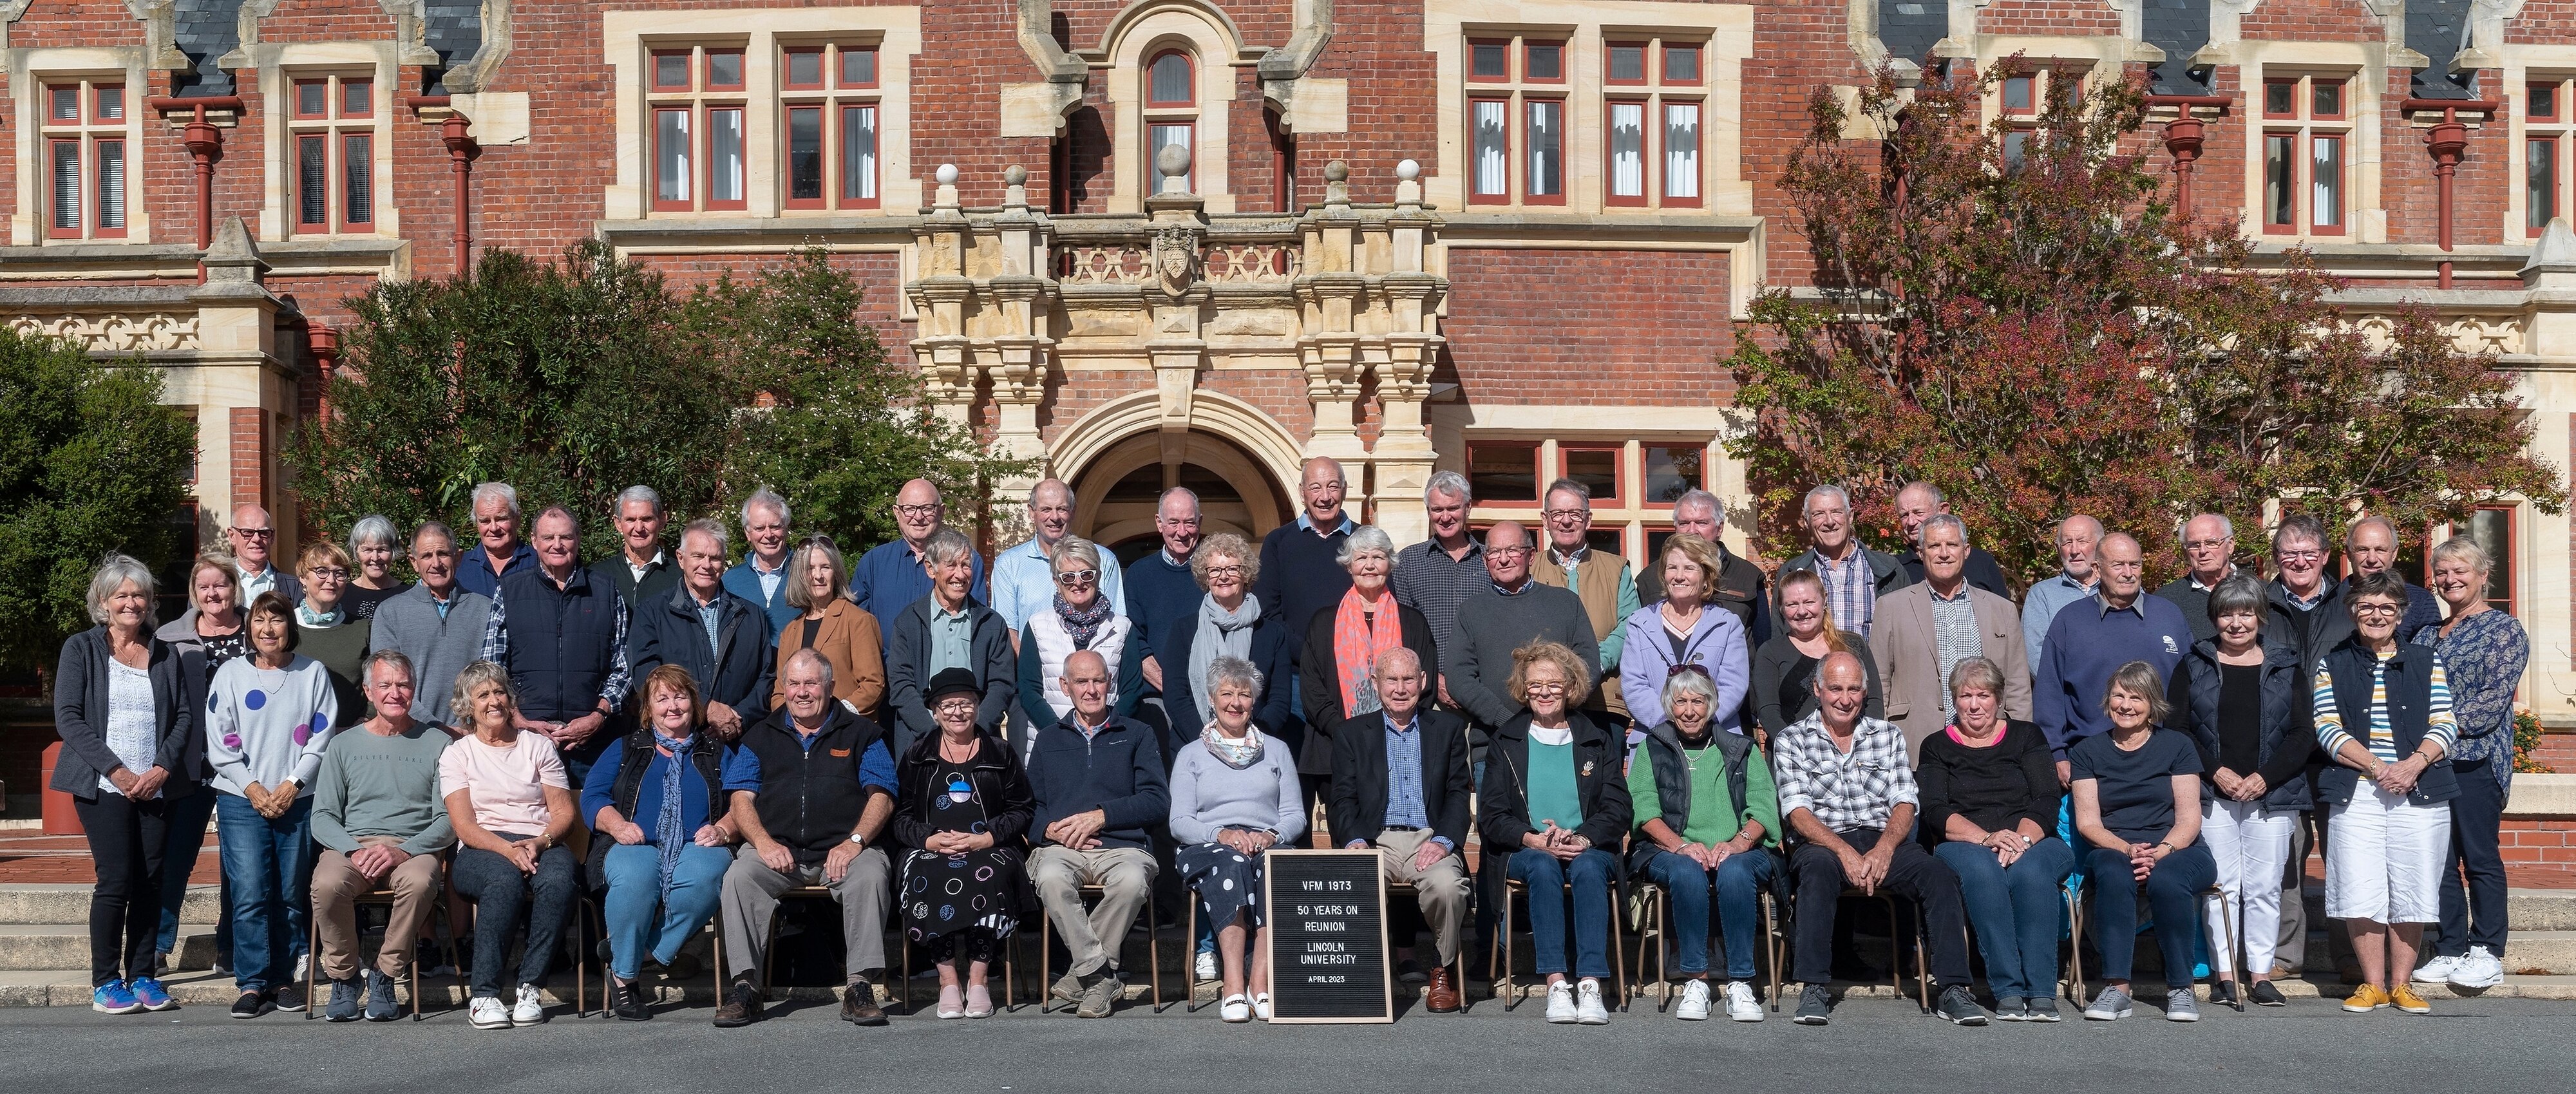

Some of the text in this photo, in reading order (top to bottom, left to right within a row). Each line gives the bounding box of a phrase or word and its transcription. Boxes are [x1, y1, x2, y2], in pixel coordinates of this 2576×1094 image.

[1162, 370, 1189, 381] 1878
[1302, 881, 1352, 891] VFM 1973
[1298, 905, 1358, 915] 50 YEARS ON
[1305, 921, 1345, 931] REUNION
[1307, 942, 1344, 952] LINCOLN
[1301, 954, 1356, 964] UNIVERSITY
